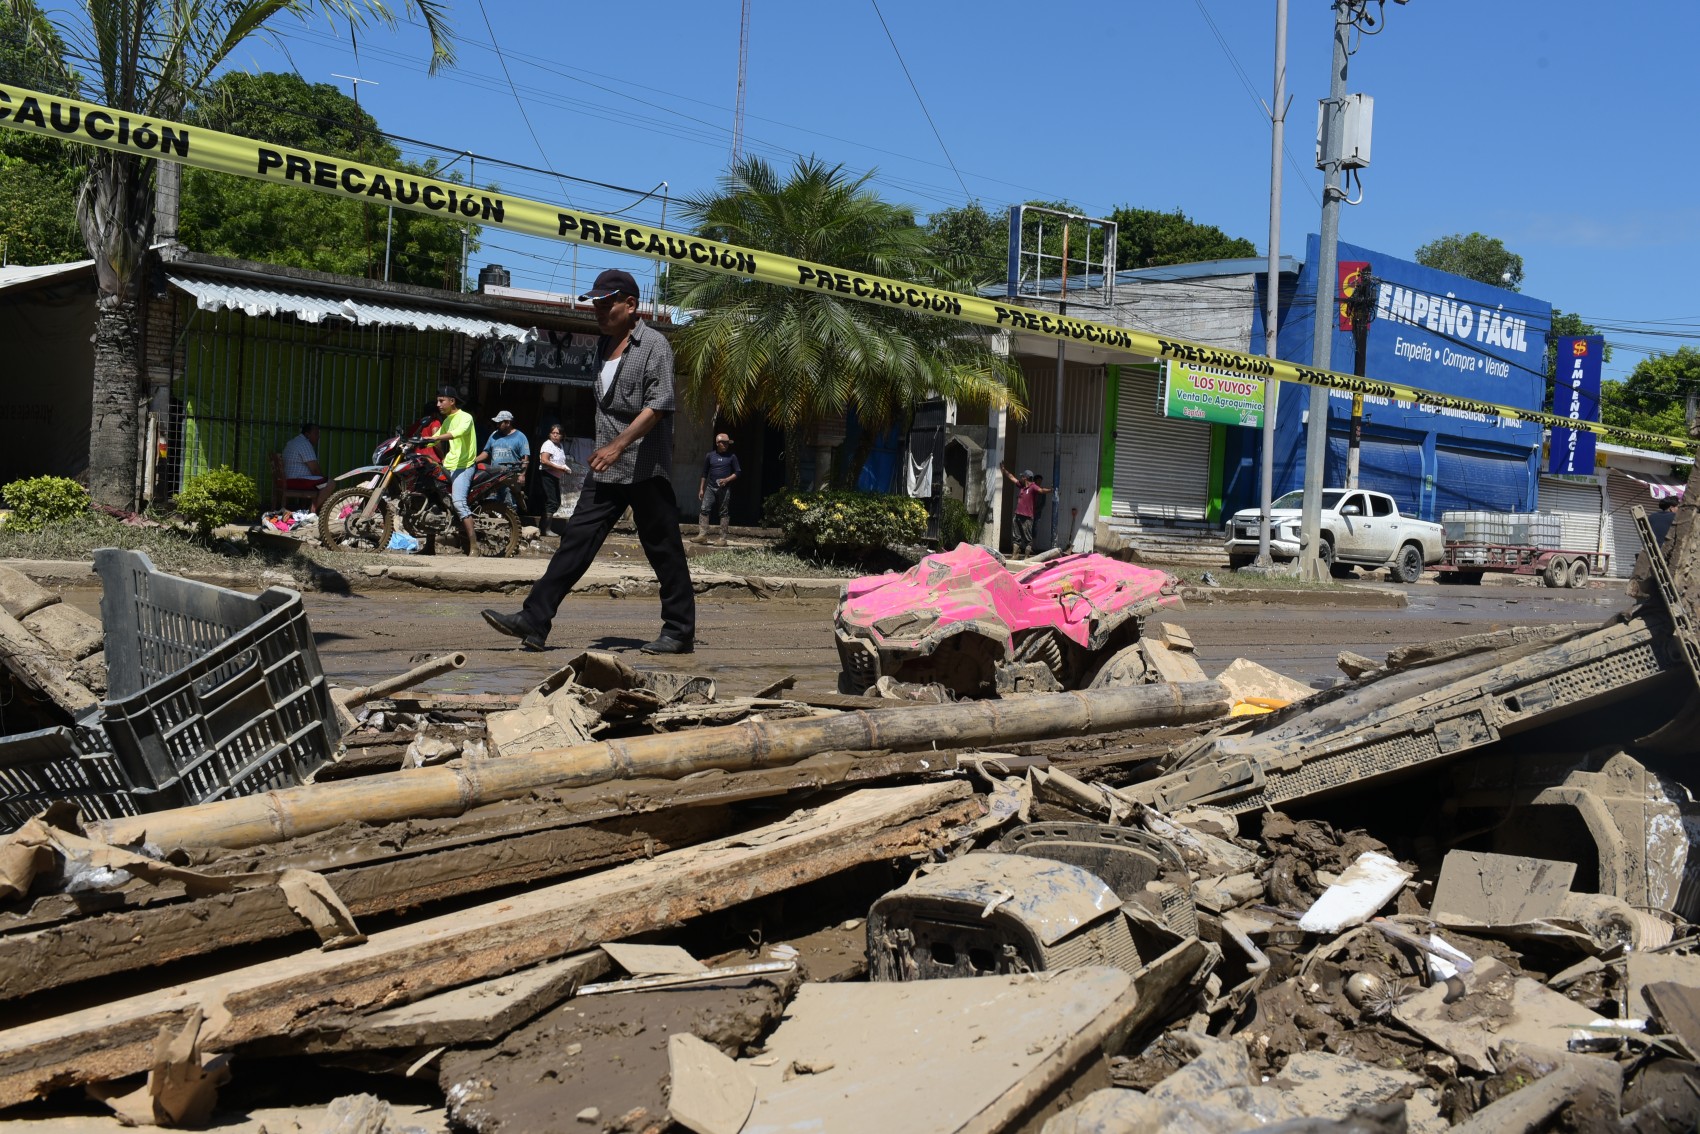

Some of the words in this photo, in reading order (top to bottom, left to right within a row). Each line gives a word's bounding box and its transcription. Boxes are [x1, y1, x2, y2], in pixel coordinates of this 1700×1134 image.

[1376, 283, 1474, 339] EMPEÑO
[1476, 303, 1527, 353] FÁCIL
[1394, 336, 1432, 362] Empeña
[1442, 347, 1475, 373] Compra
[1485, 356, 1510, 378] Vende
[1177, 389, 1200, 402] Venta
[1202, 394, 1212, 403] De
[1567, 426, 1578, 472] ÁCIL
